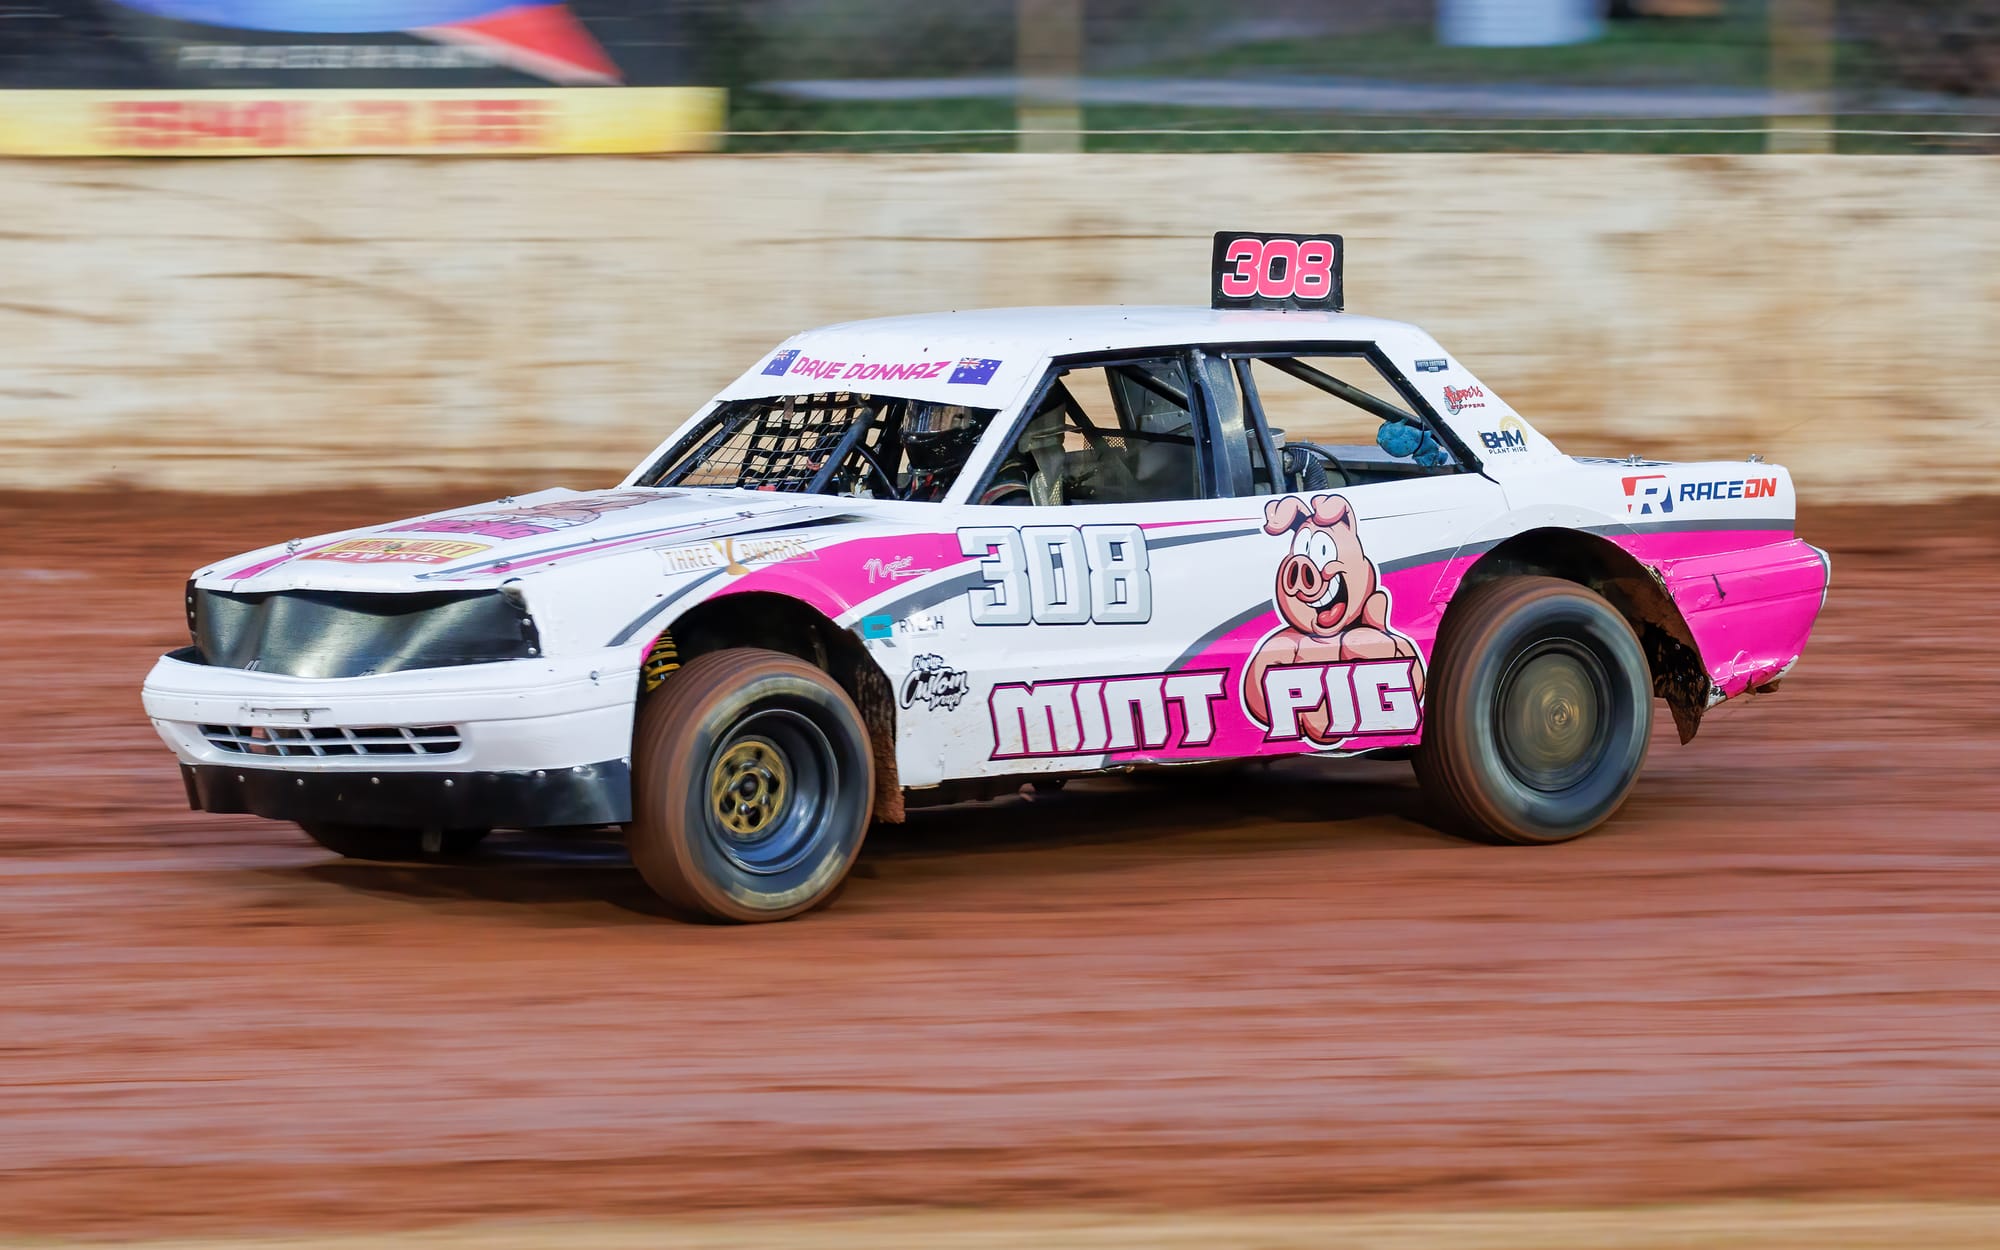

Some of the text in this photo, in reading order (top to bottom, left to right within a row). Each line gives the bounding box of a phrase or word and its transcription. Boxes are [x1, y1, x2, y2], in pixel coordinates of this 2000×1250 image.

[1221, 238, 1335, 299] 308
[790, 356, 952, 380] DAVE DONNAZ
[1480, 429, 1526, 449] BHM
[316, 552, 440, 563] TOWING
[664, 538, 811, 571] THREE AWARDS
[956, 523, 1152, 626] 308
[988, 657, 1423, 761] MINT PIG
